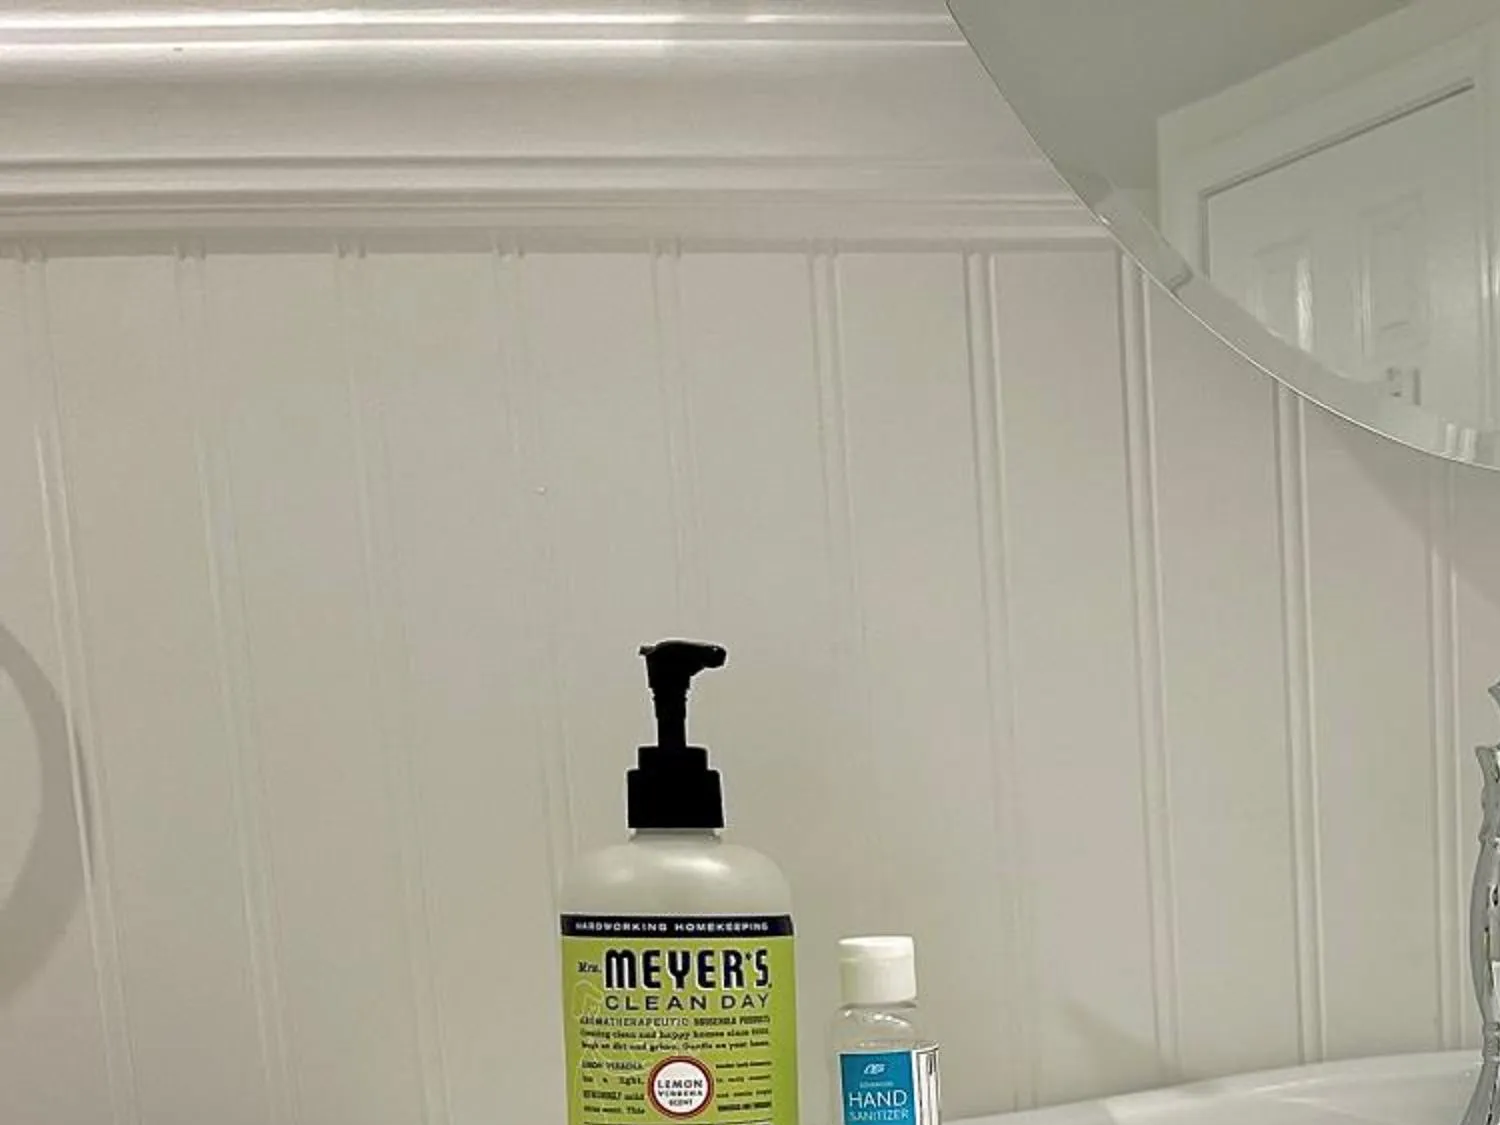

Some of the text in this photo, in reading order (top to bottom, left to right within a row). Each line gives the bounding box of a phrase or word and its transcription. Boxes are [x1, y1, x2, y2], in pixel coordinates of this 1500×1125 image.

[575, 921, 769, 932] HARDWORKING HOMEKEEPING
[603, 948, 769, 990] MEYER'S
[604, 993, 770, 1011] CLEAN DAY
[657, 1079, 704, 1089] LEMON
[848, 1089, 908, 1109] HAND
[849, 1108, 910, 1121] SANITIZER
